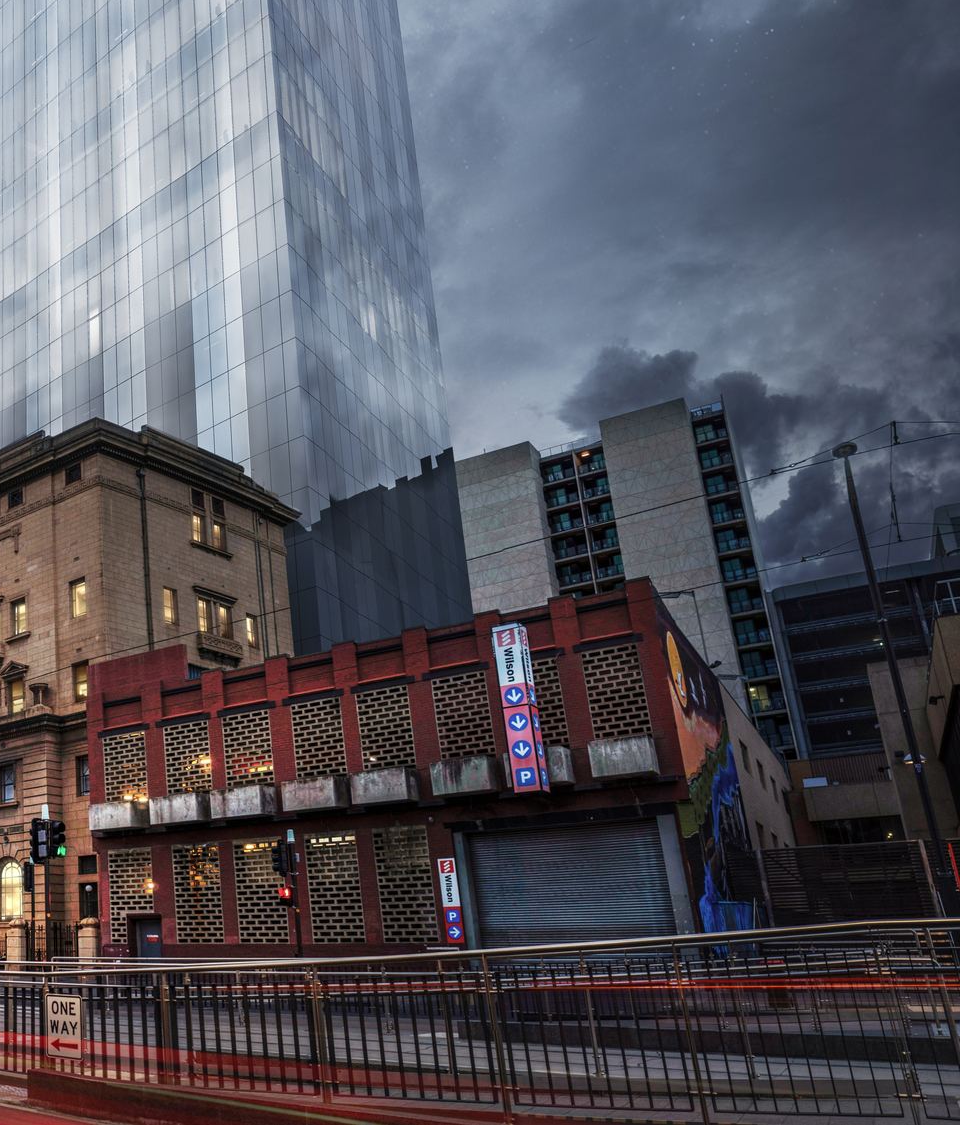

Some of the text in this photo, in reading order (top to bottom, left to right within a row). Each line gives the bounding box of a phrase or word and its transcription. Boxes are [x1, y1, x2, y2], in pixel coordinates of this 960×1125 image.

[504, 647, 515, 682] Wilson
[520, 770, 532, 784] P
[444, 874, 453, 903] Wilson
[448, 911, 457, 921] P
[51, 1000, 76, 1016] ONE
[50, 1019, 78, 1036] WAY
